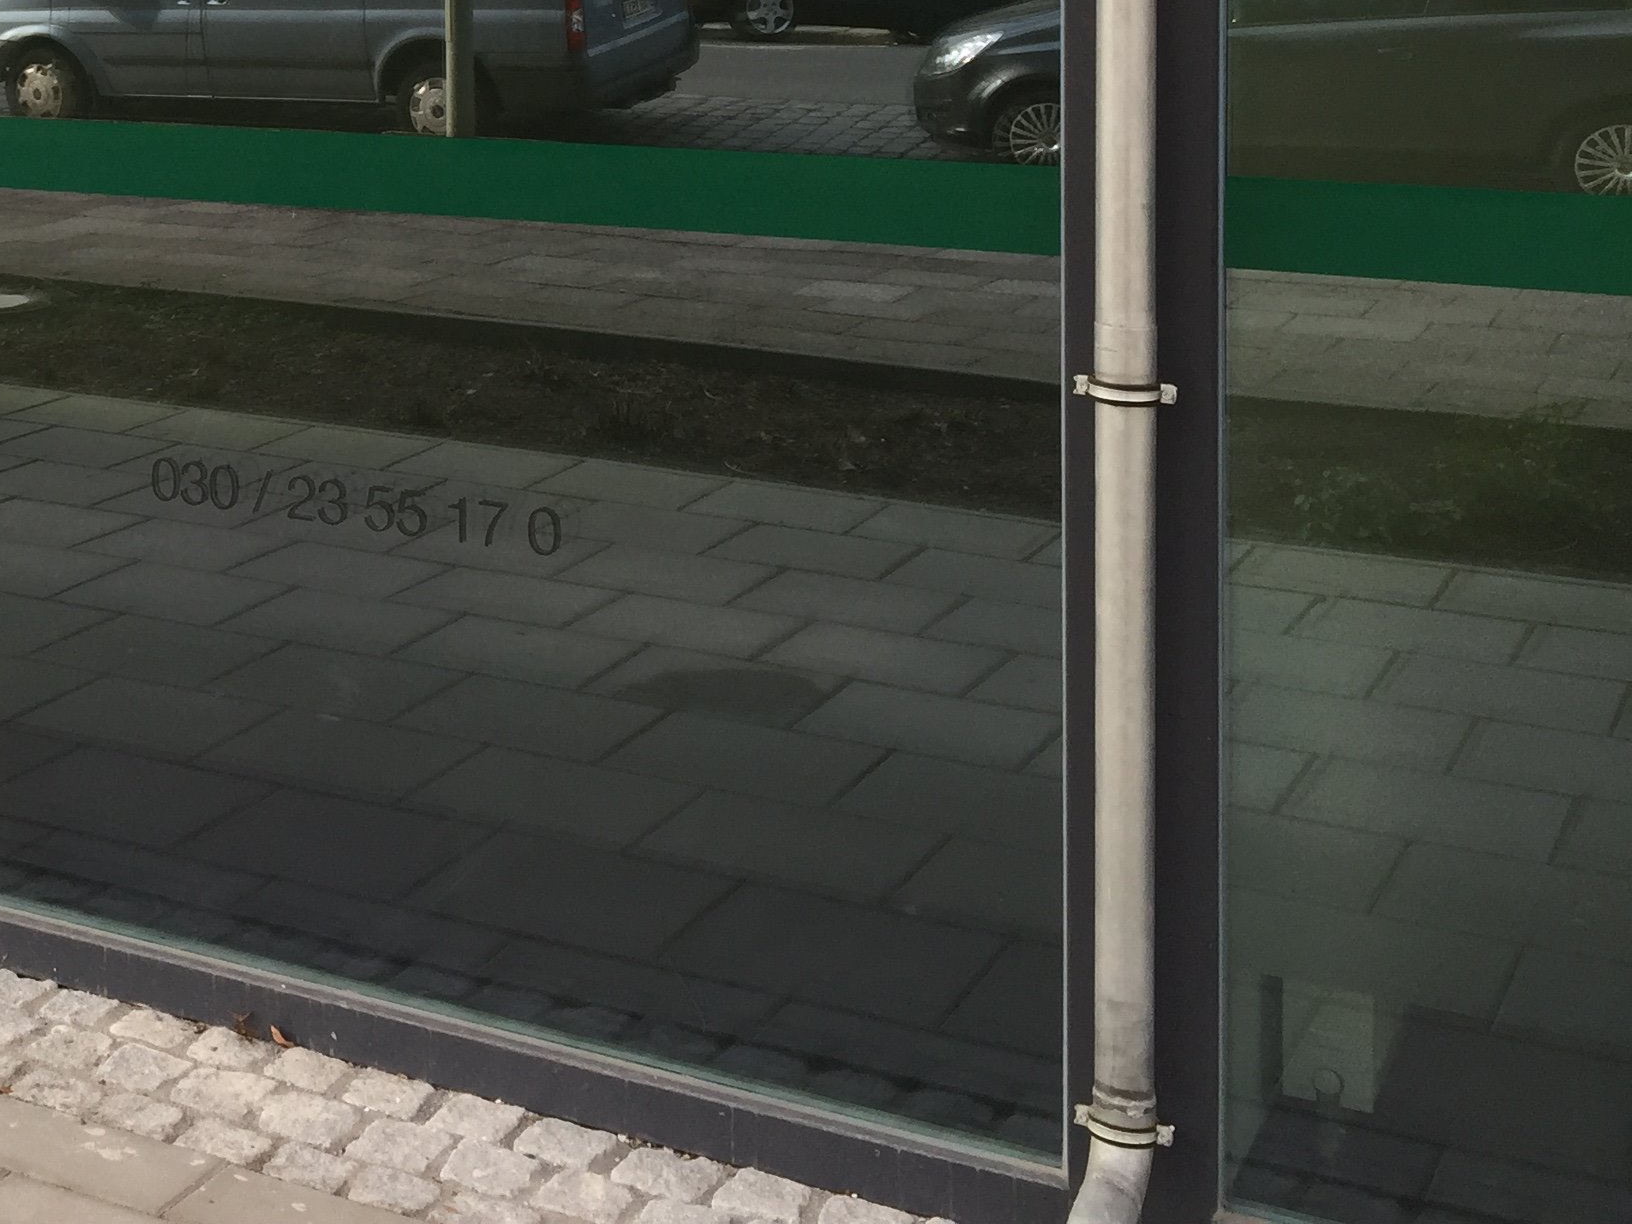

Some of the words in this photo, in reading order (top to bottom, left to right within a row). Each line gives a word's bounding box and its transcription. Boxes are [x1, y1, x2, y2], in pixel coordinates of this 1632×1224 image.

[151, 456, 240, 511] 030
[287, 475, 348, 525] 23
[364, 485, 428, 537] 55
[447, 496, 508, 547] 17
[527, 506, 562, 556] 0
